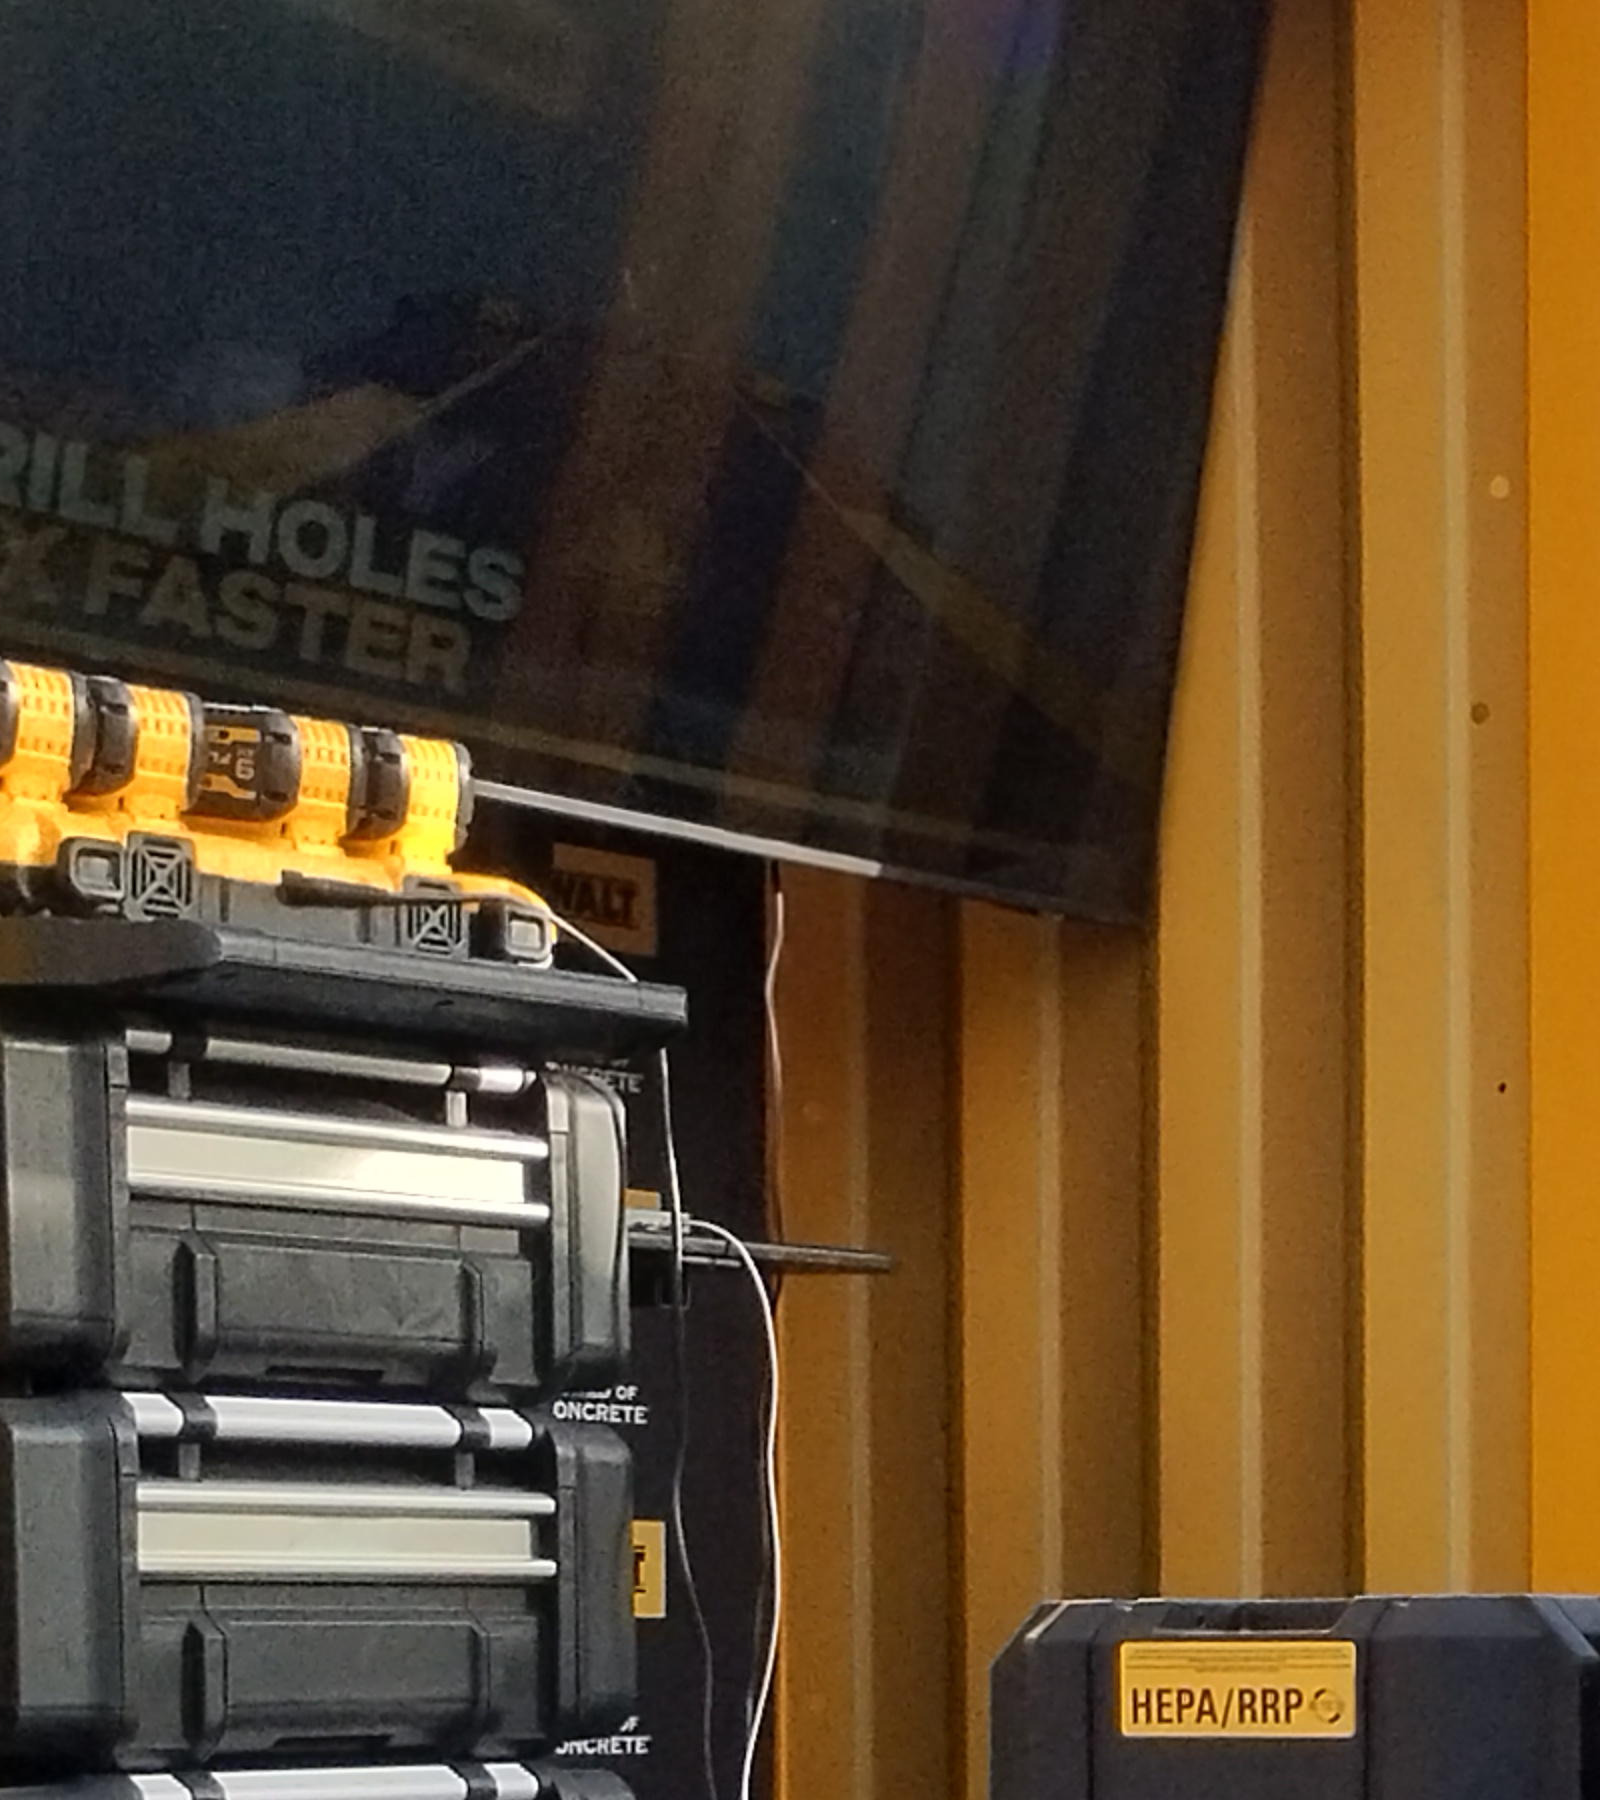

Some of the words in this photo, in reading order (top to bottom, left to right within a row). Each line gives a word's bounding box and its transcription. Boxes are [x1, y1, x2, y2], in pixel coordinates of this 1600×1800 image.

[199, 477, 525, 622] HOLES
[84, 538, 474, 695] FASTER
[553, 1402, 648, 1424] ONCRETE
[1131, 1687, 1304, 1729] HEPA/RRP
